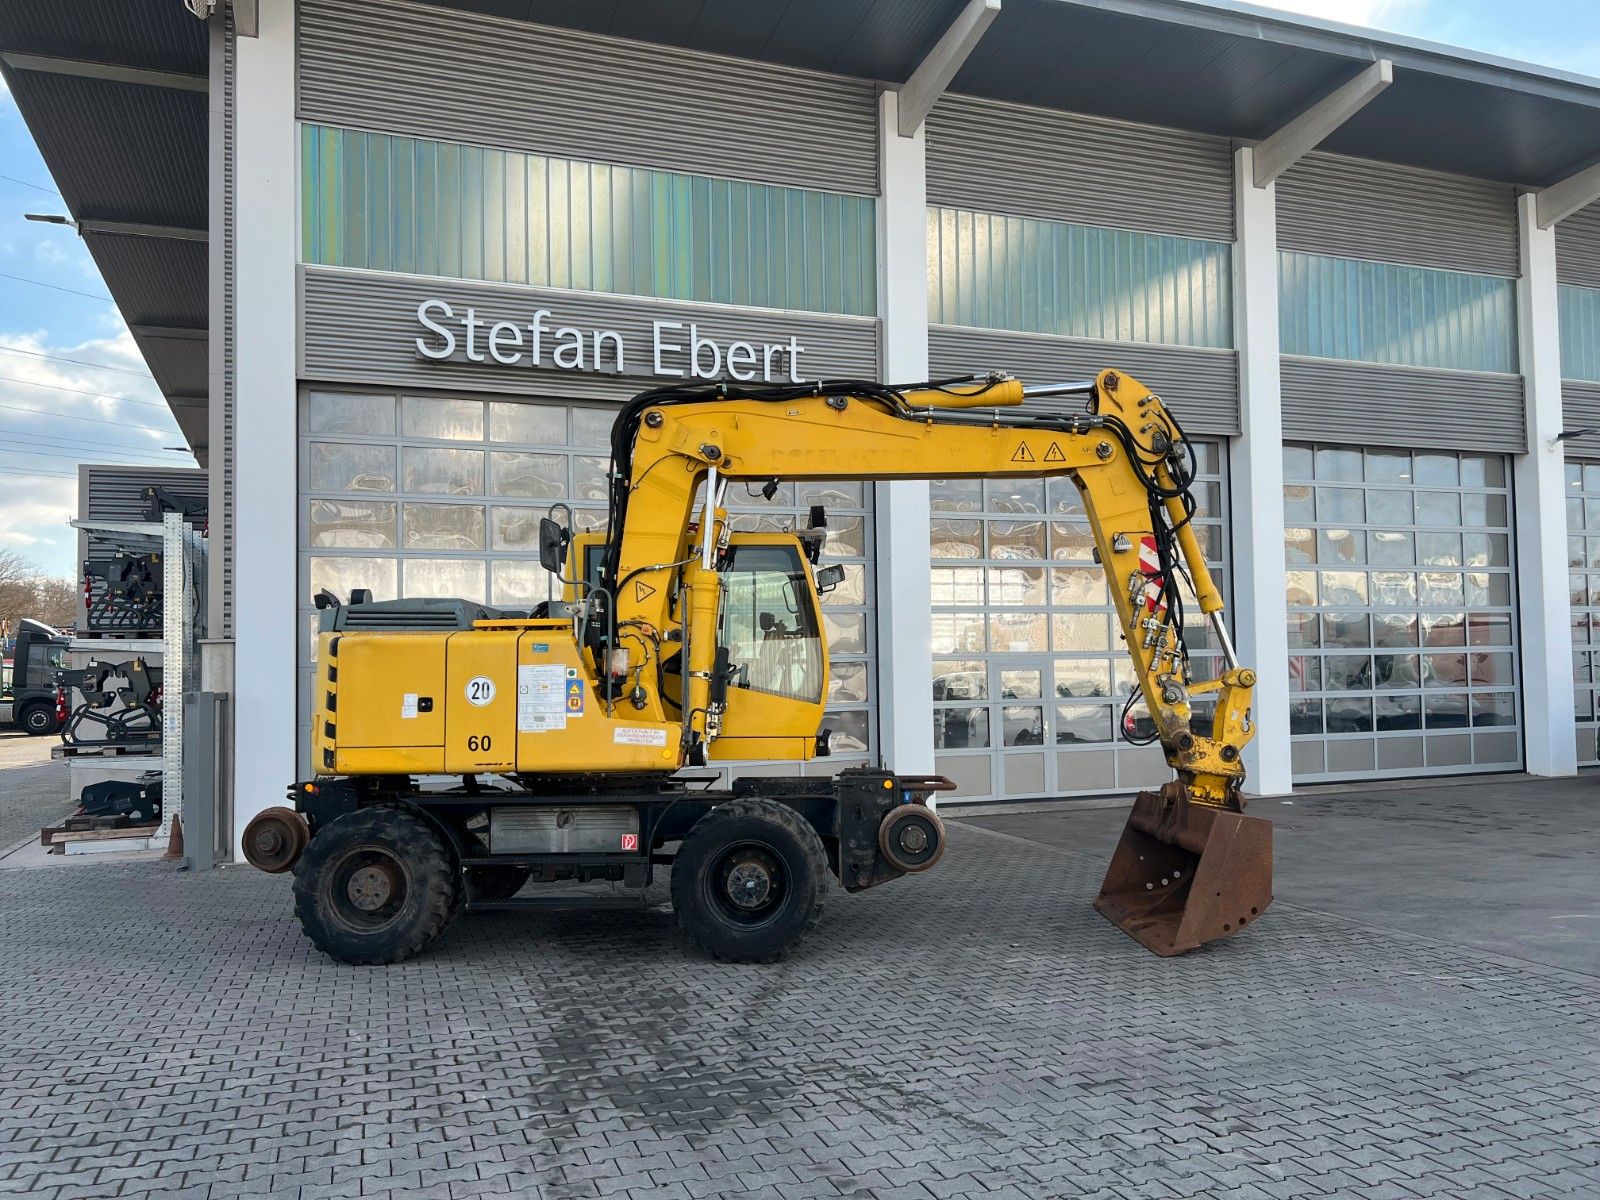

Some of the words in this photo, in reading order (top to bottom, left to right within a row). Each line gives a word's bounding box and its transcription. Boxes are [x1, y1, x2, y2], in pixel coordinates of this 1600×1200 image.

[416, 299, 624, 373] Stefan
[653, 321, 806, 383] Ebert
[471, 681, 490, 700] 20
[467, 735, 492, 752] 60
